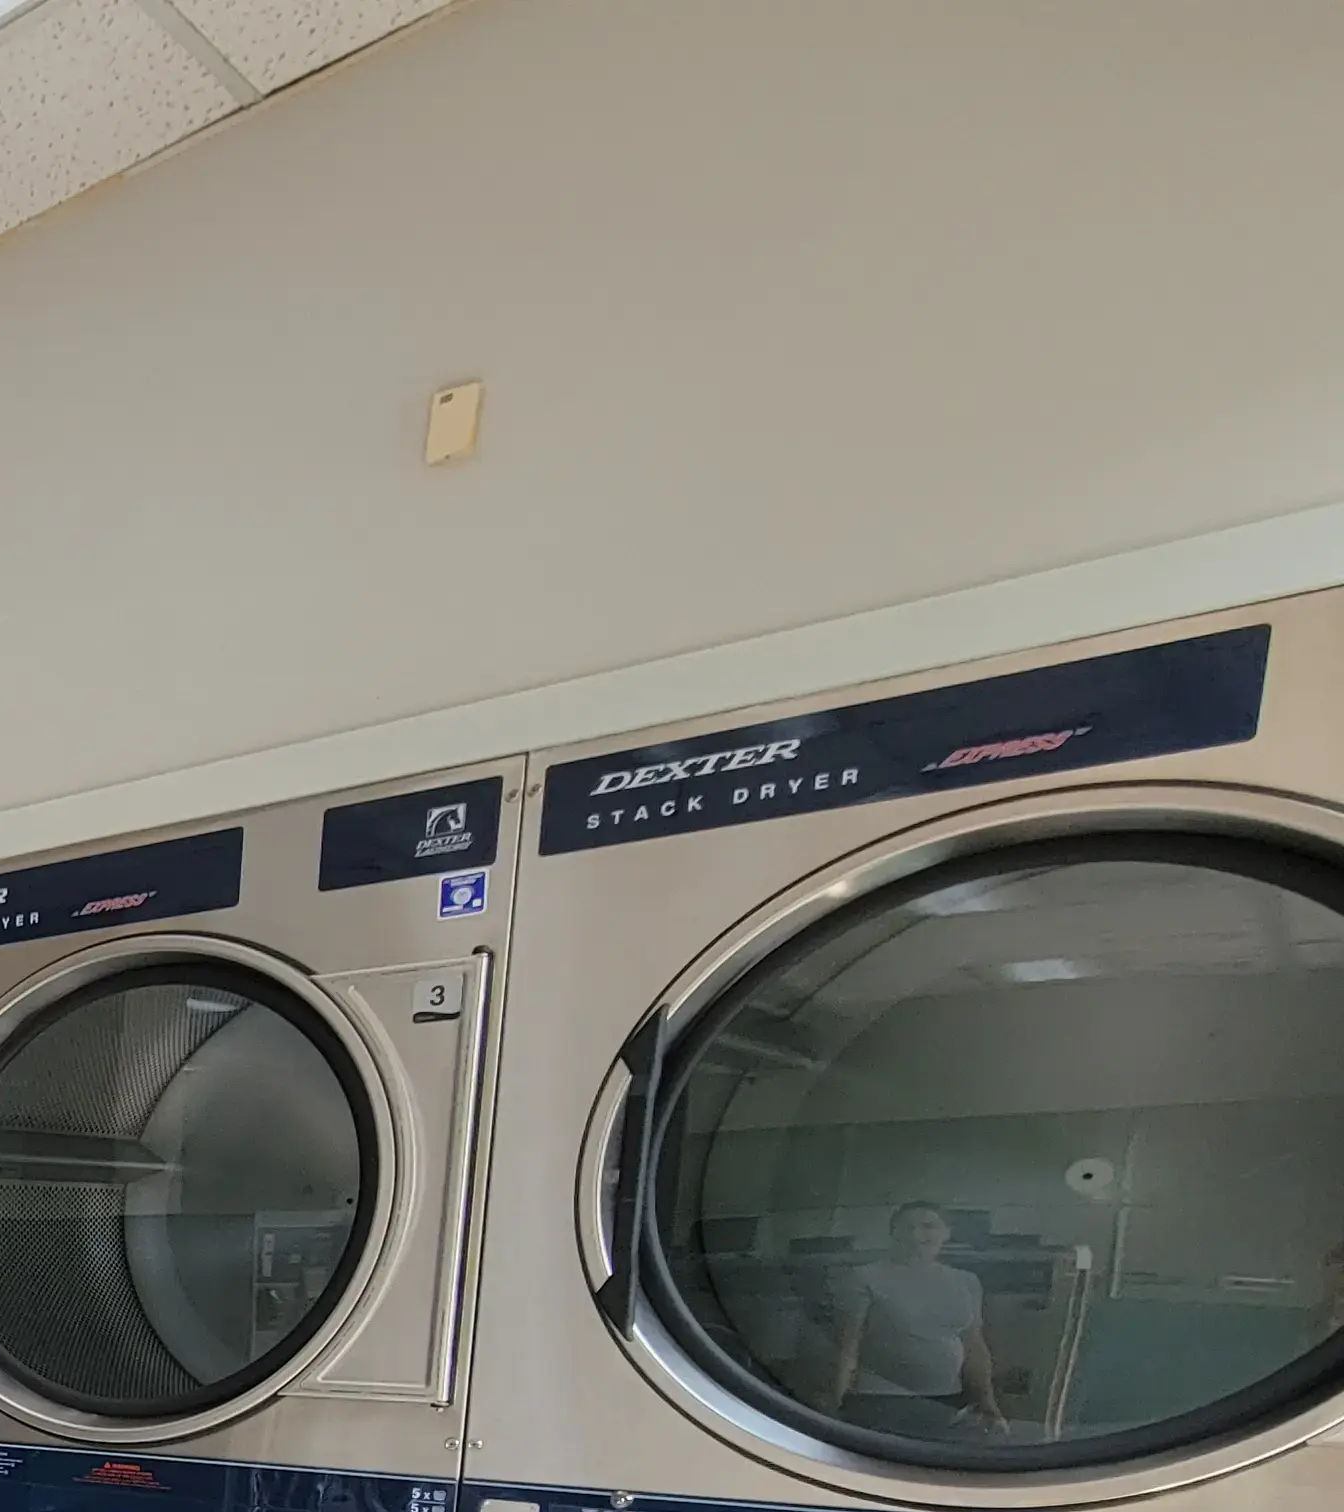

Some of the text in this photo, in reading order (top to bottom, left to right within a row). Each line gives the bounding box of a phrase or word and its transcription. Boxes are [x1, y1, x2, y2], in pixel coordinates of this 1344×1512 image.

[589, 738, 801, 797] DEXTER
[586, 768, 859, 829] STACK DRYER
[430, 985, 445, 1006] 3
[412, 1487, 421, 1499] 5
